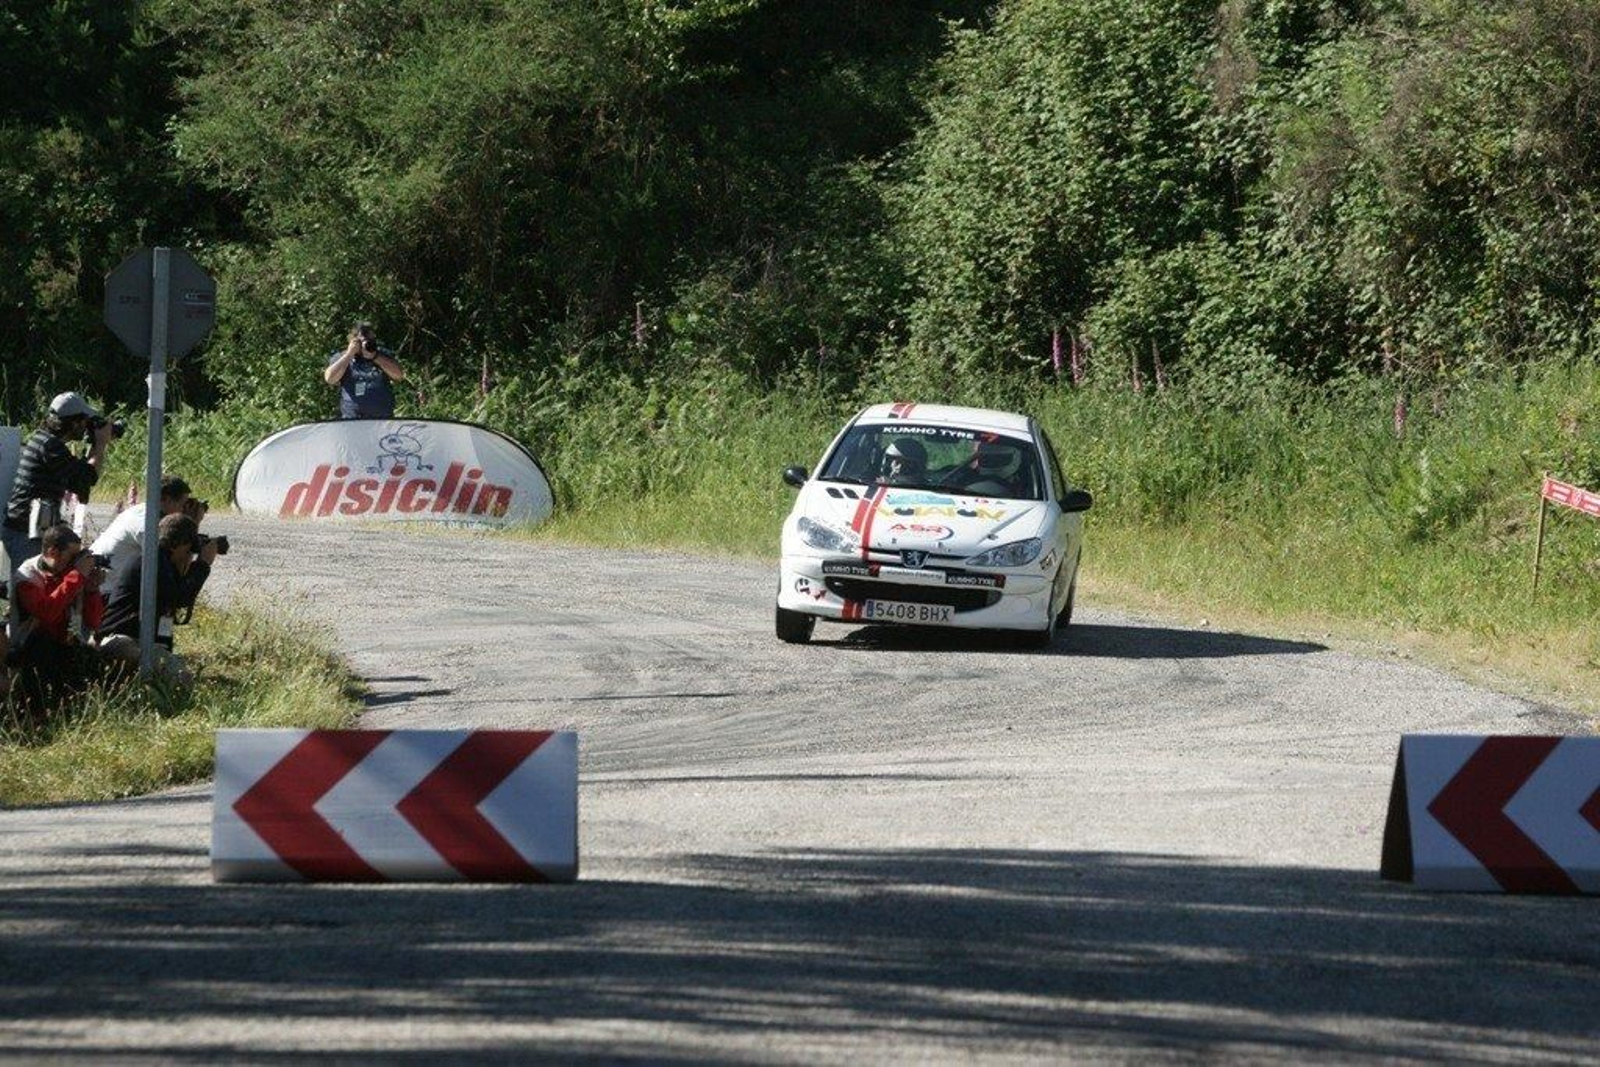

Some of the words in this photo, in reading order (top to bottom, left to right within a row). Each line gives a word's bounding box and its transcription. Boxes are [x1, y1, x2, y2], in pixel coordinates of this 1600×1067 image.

[882, 426, 937, 436] KUMHO
[940, 429, 975, 440] TYRE
[278, 462, 514, 519] disiclin
[875, 602, 917, 619] 5408
[919, 605, 951, 622] BHX
